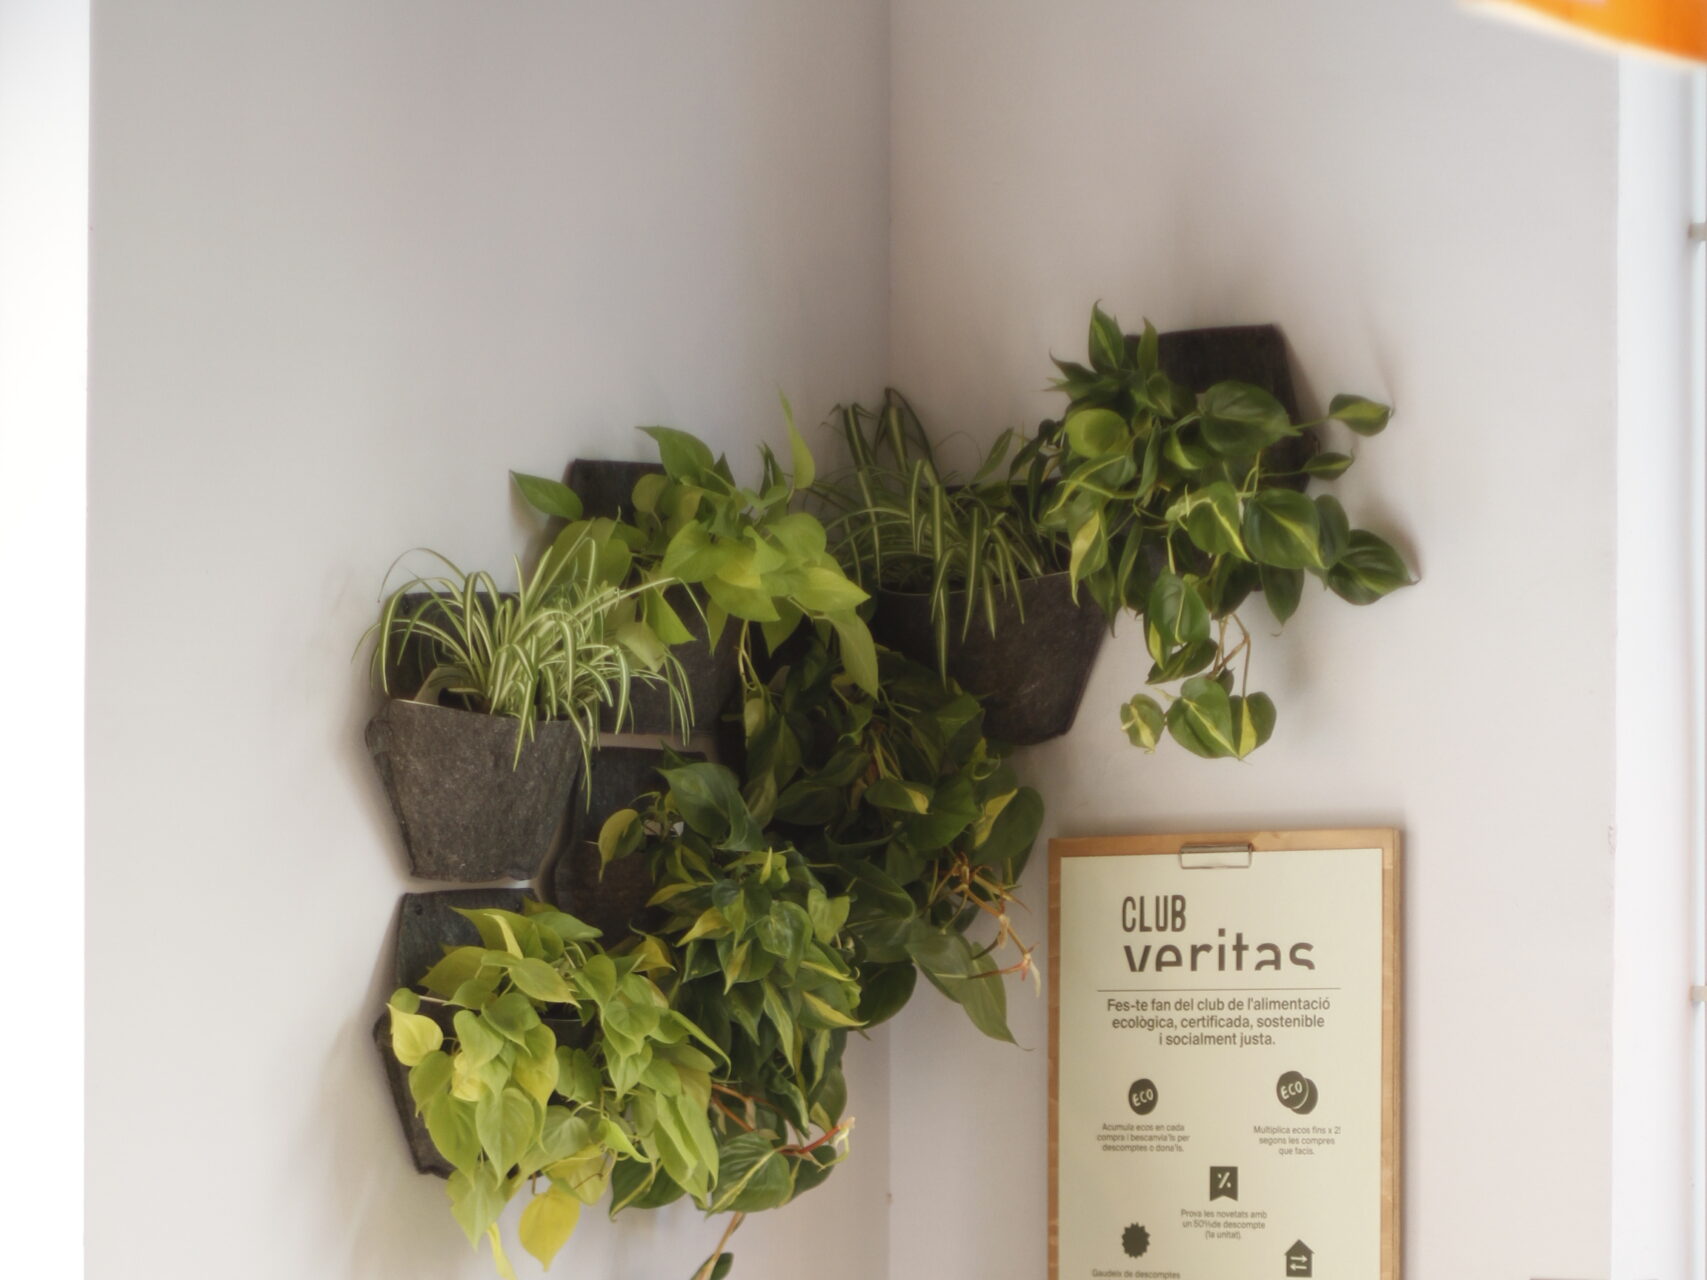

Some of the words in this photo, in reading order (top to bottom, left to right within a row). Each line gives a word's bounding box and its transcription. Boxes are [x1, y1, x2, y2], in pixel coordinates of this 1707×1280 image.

[1122, 894, 1187, 933] CLUB
[1123, 928, 1316, 972] veritas
[1107, 998, 1148, 1012] Fes-te
[1151, 998, 1171, 1011] fan
[1174, 998, 1194, 1011] del
[1198, 998, 1225, 1011] club
[1228, 998, 1244, 1010] de
[1248, 997, 1330, 1011] l'alimentació
[1112, 1016, 1178, 1032] ecològica,
[1180, 1015, 1254, 1030] certificada,
[1256, 1014, 1325, 1028] sostenible
[1159, 1033, 1163, 1045] i
[1165, 1033, 1237, 1046] socialment
[1239, 1033, 1276, 1048] justa.
[1132, 1088, 1154, 1107] ECO
[1280, 1080, 1303, 1100] ECO
[1253, 1126, 1290, 1135] Multiplica
[1216, 1210, 1248, 1219] novetats
